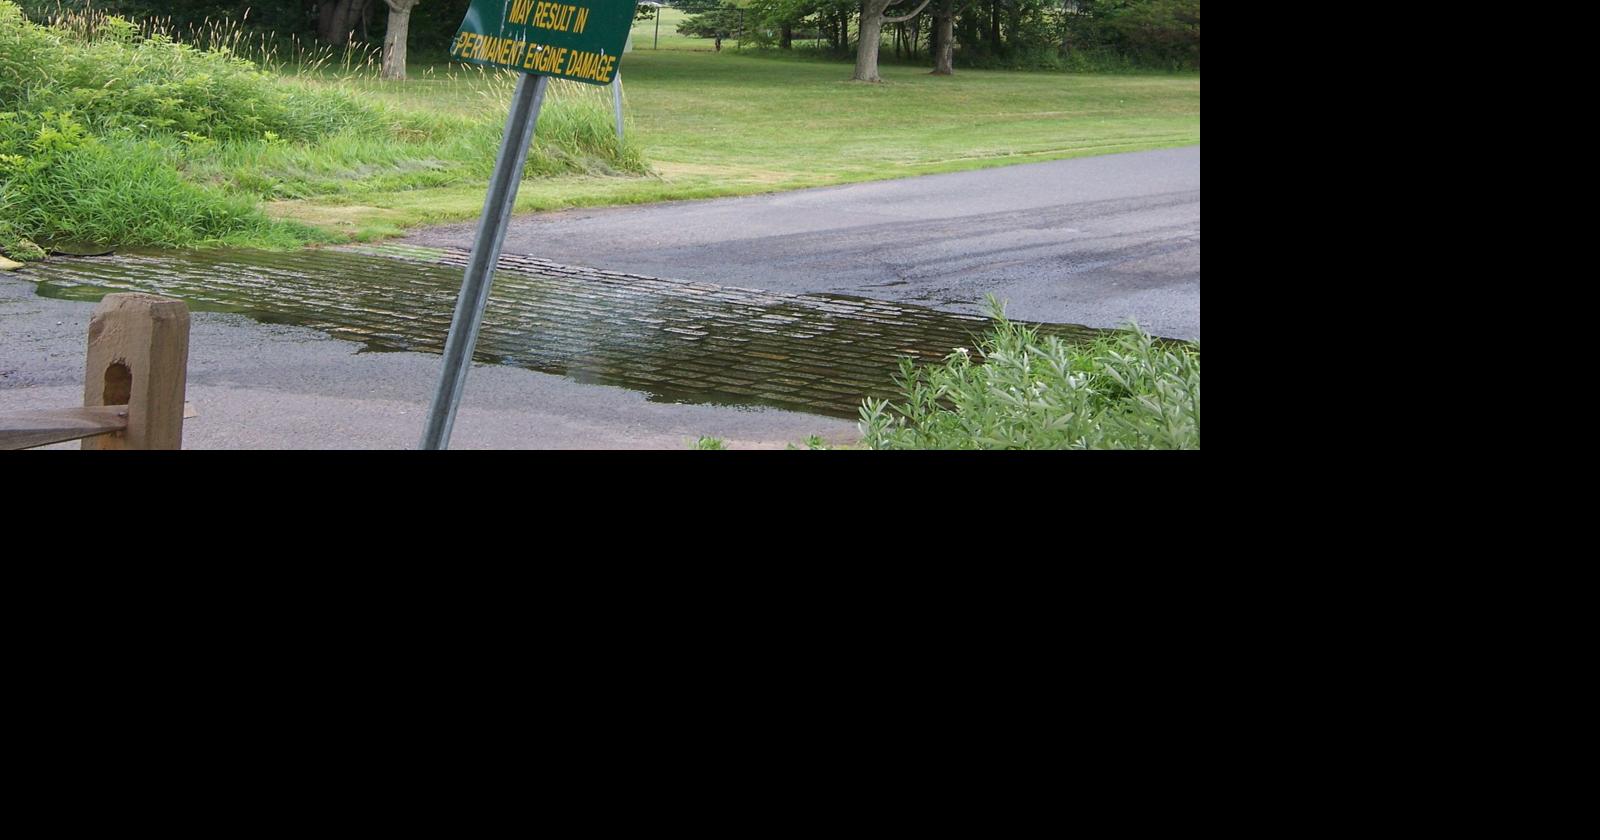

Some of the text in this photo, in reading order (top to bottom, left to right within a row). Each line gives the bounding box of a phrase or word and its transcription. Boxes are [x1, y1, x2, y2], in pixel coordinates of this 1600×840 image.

[508, 0, 589, 33] MAY RESULT IN
[456, 31, 616, 82] PERMANENT ENGINE DAMAGE
